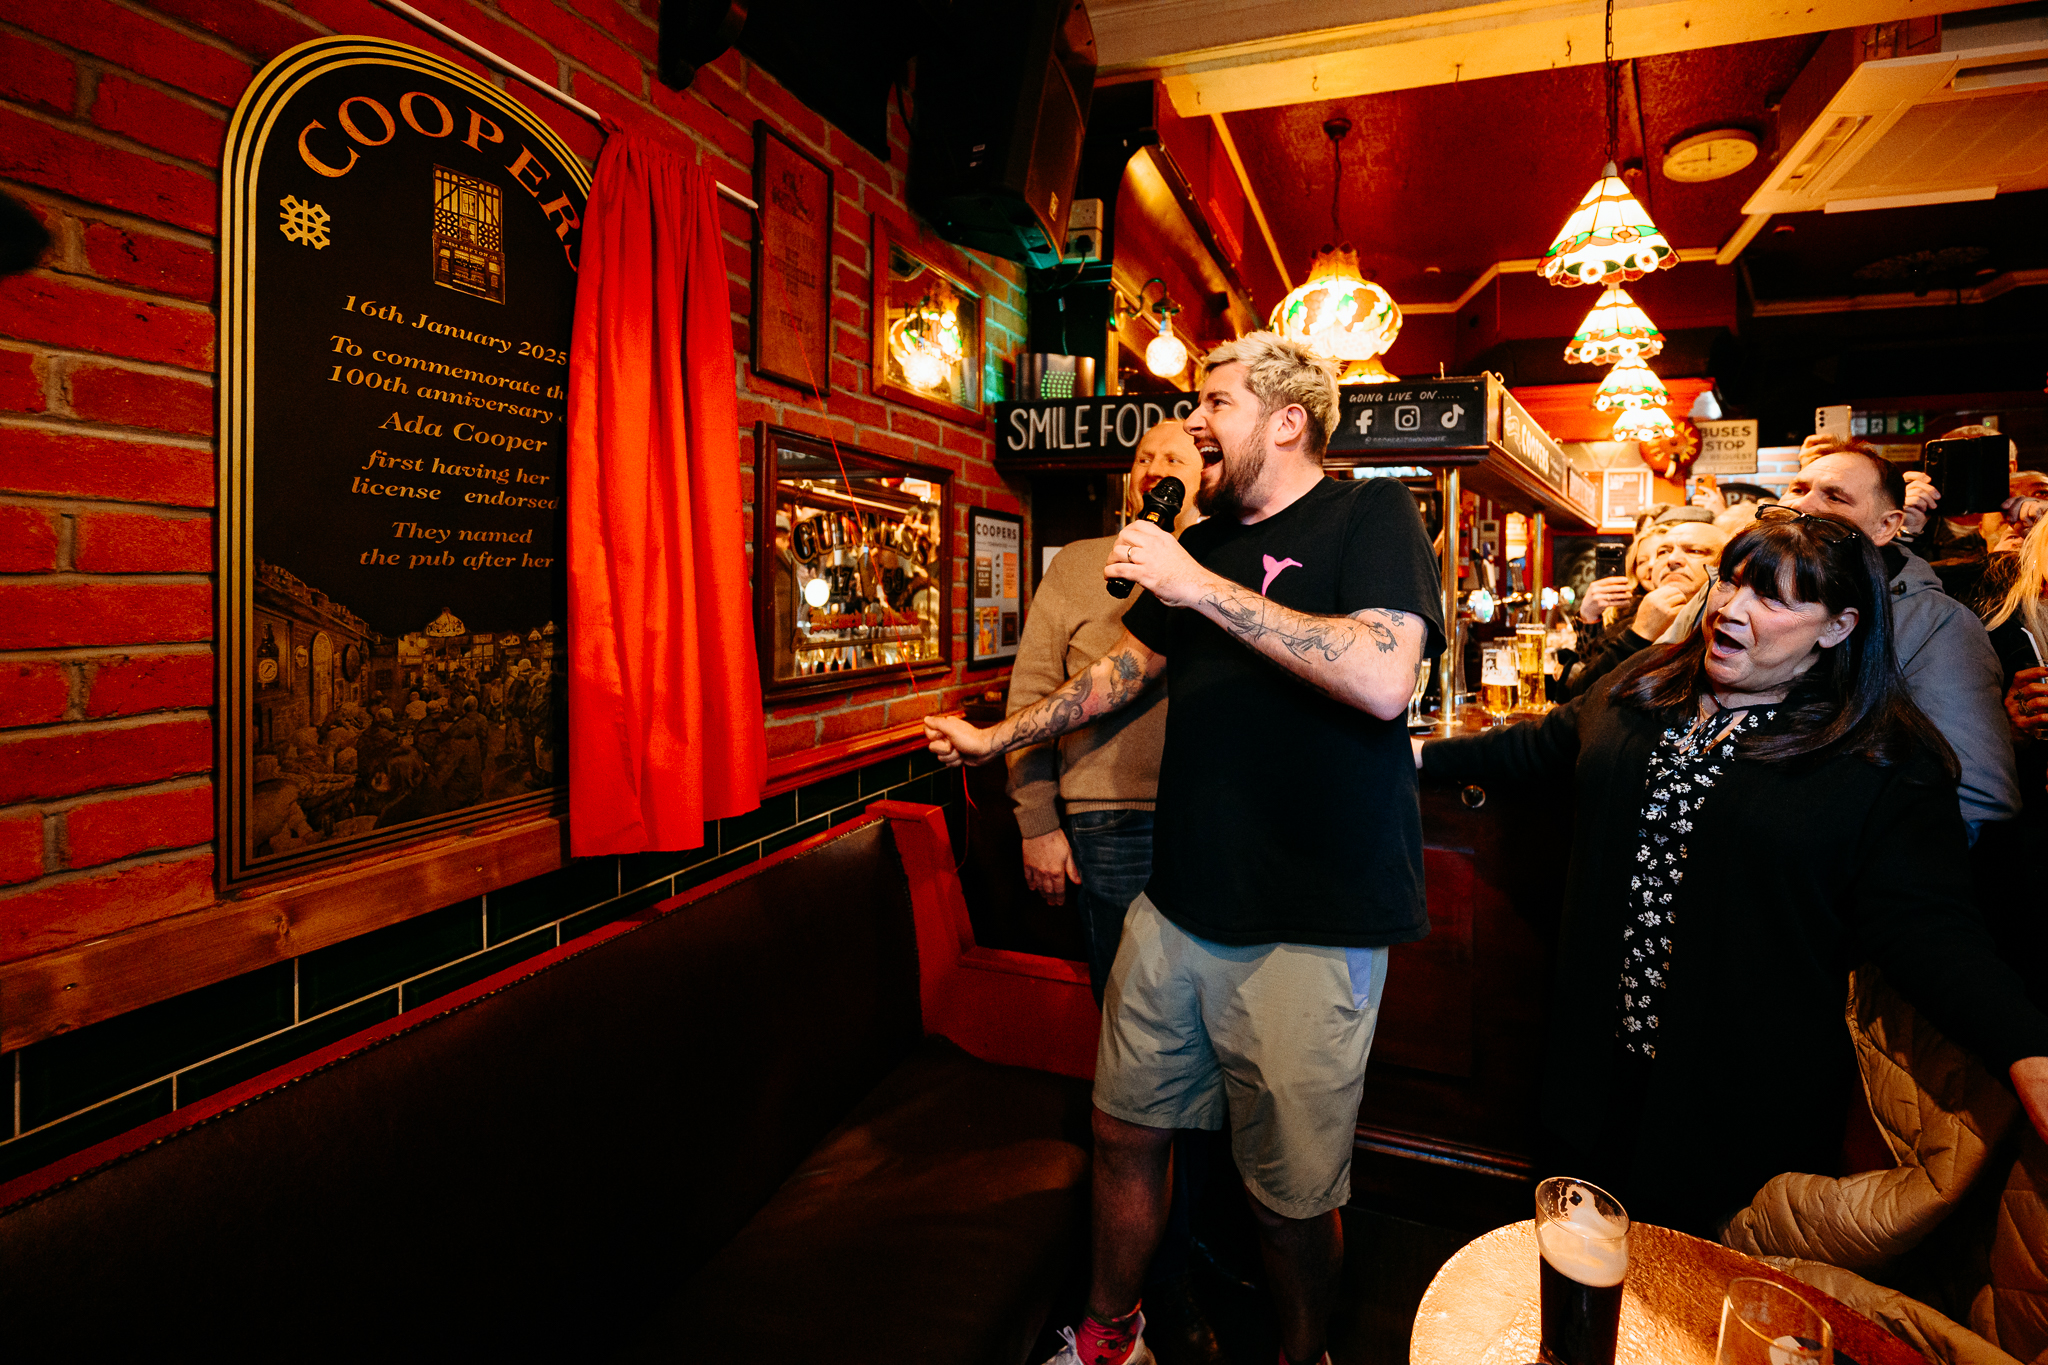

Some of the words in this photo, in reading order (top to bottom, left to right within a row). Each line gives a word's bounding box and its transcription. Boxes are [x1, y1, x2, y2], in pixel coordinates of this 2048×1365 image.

[342, 294, 404, 325] 16th
[411, 313, 512, 354] January
[518, 341, 568, 366] 2025
[330, 335, 363, 357] To
[372, 350, 541, 395] commemorate
[546, 385, 566, 401] th
[327, 365, 409, 395] 100th
[416, 386, 554, 424] anniversary
[1349, 393, 1383, 403] GOING
[1388, 391, 1413, 401] LIVE
[378, 411, 443, 438] Ada
[453, 422, 548, 452] Cooper
[1007, 405, 1091, 451] SMILE
[1701, 425, 1751, 438] BUSES
[1705, 439, 1745, 452] STOP
[361, 449, 424, 472] first
[431, 457, 510, 485] having
[516, 468, 550, 485] her
[351, 476, 442, 500] license
[464, 490, 560, 510] endorsed
[391, 521, 451, 544] They
[458, 529, 533, 544] named
[791, 510, 931, 567] GUINNESS
[976, 523, 1017, 540] COOPERS
[359, 548, 401, 566] the
[409, 551, 455, 569] pub
[463, 551, 516, 570] after
[522, 553, 554, 568] her
[831, 566, 854, 596] 17
[883, 567, 905, 594] 59
